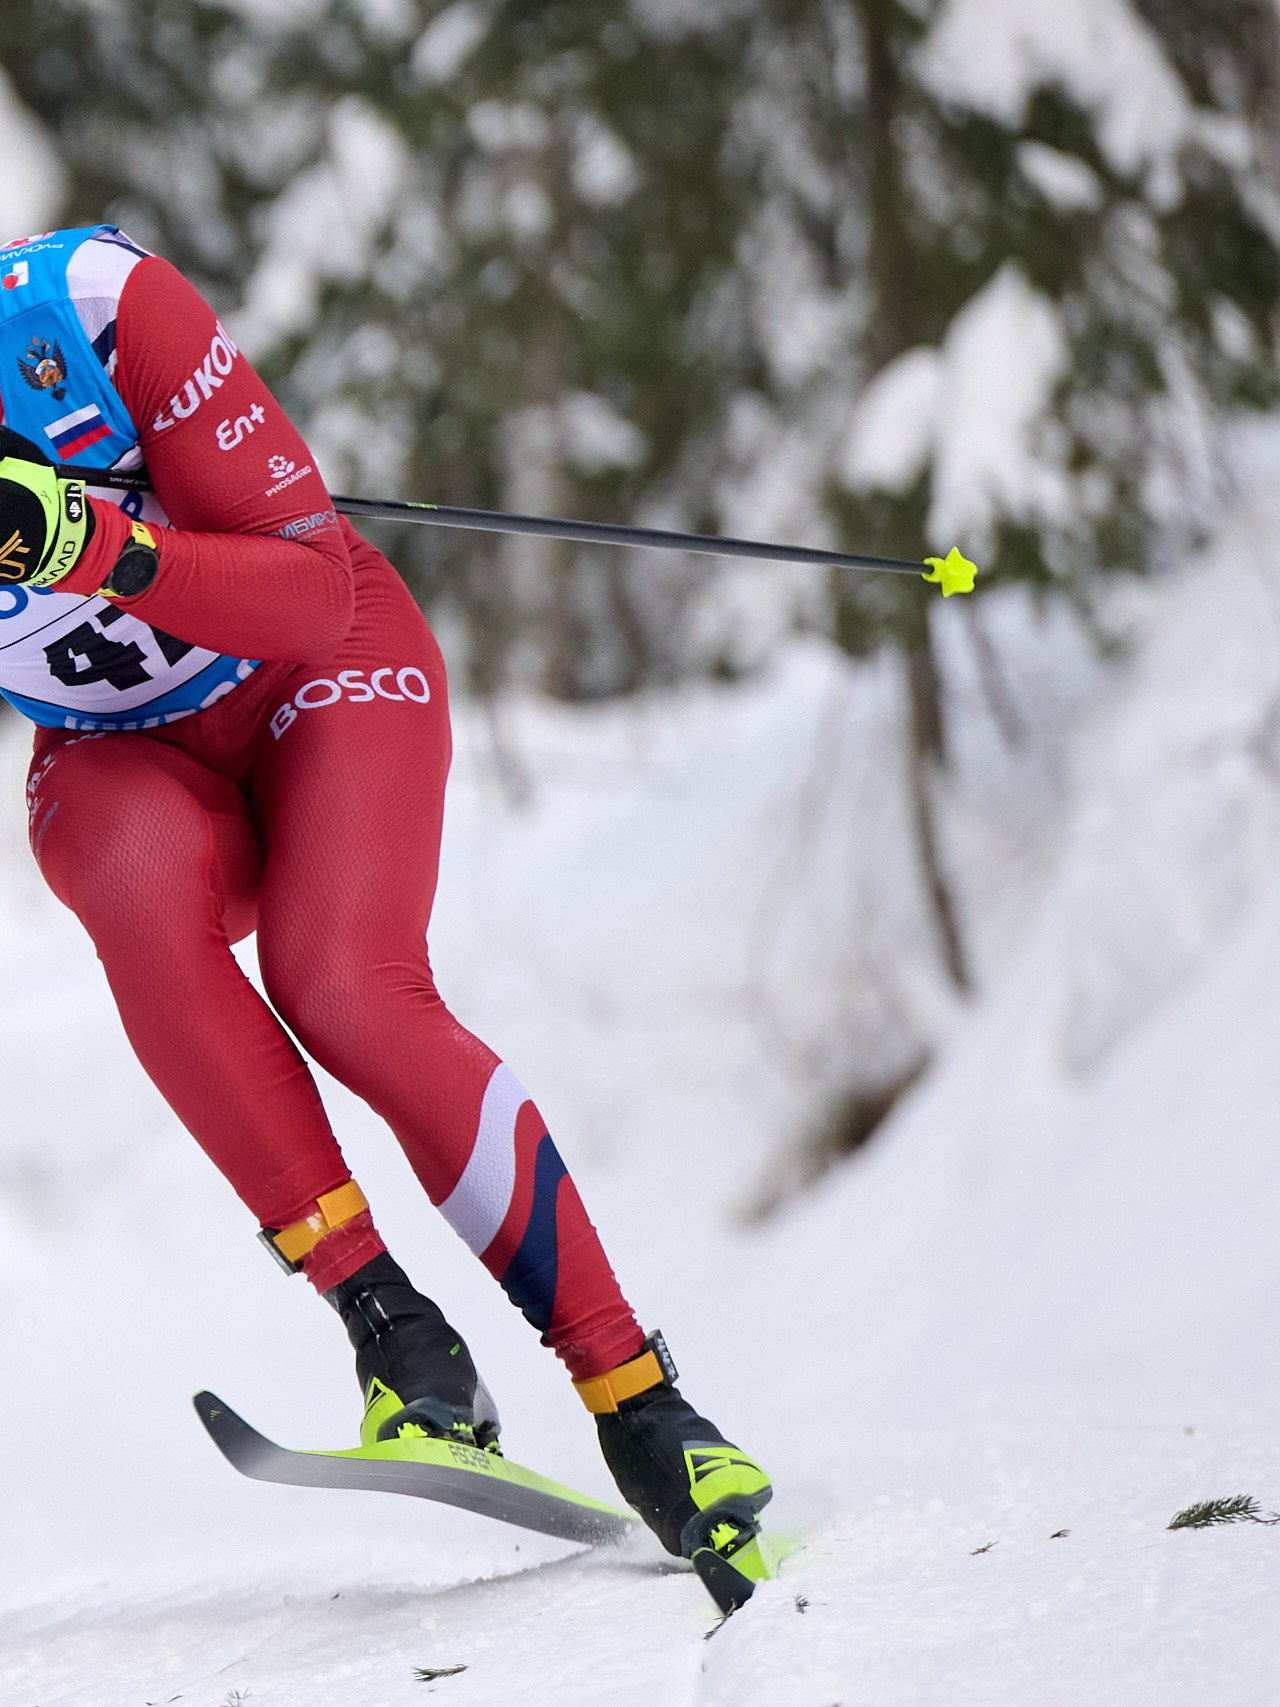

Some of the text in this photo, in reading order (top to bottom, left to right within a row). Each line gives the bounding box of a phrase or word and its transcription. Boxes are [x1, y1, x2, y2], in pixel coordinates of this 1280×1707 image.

[215, 403, 266, 451] En+
[265, 465, 312, 498] PHOSAGRO
[269, 666, 431, 740] BOSCO
